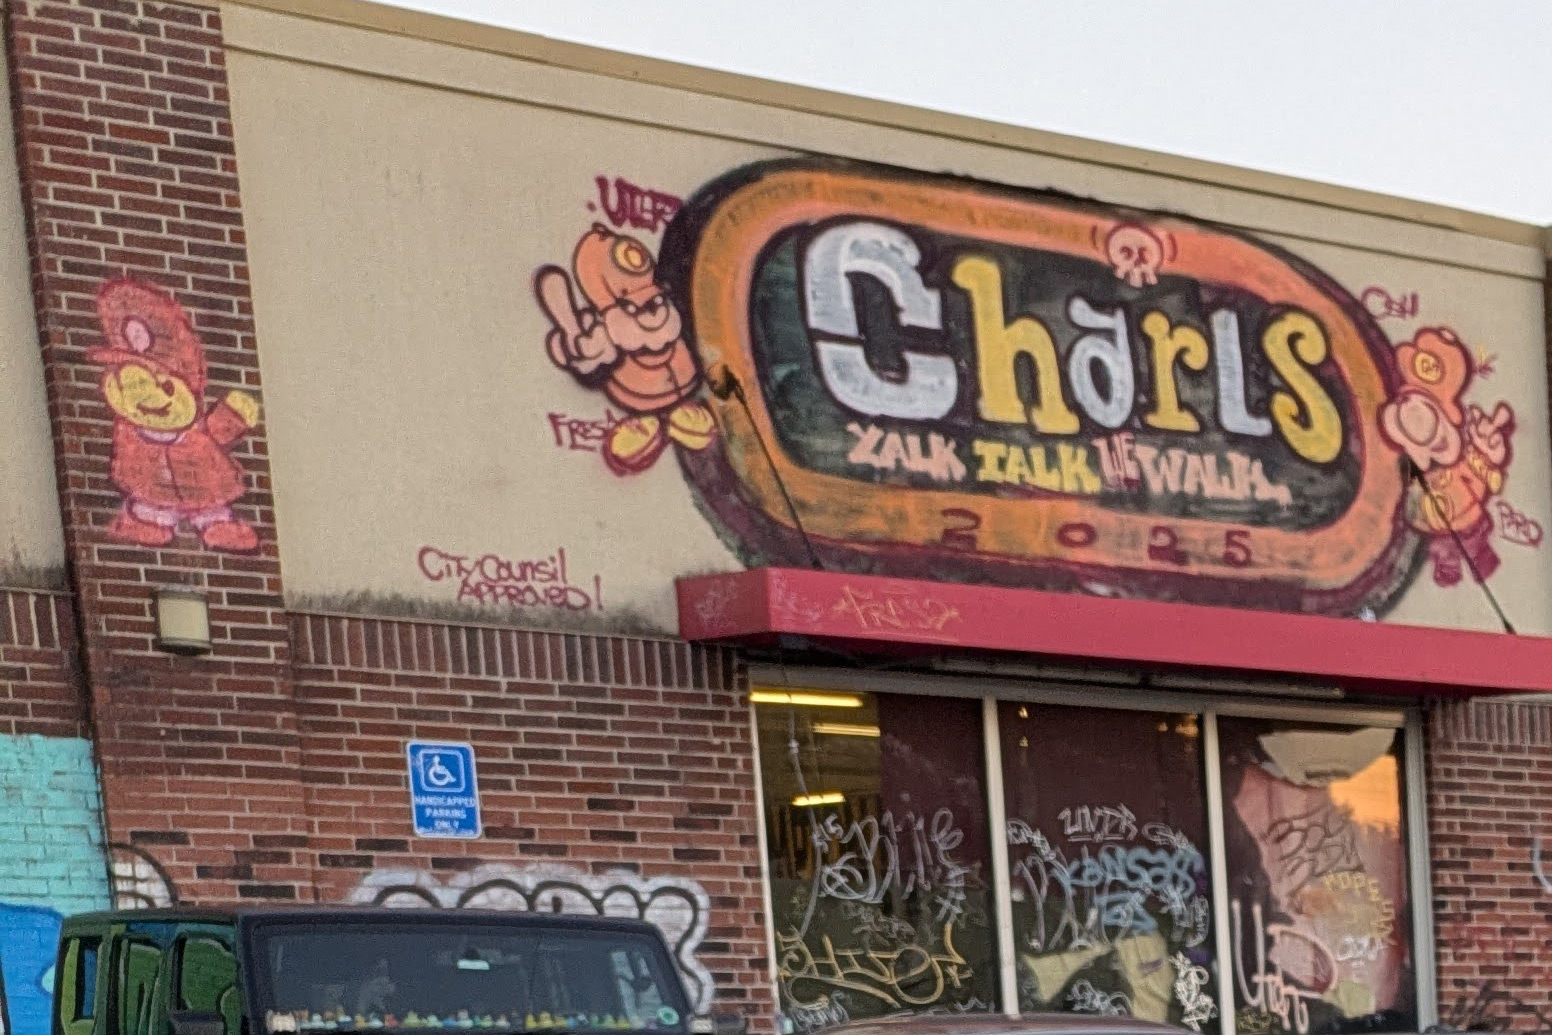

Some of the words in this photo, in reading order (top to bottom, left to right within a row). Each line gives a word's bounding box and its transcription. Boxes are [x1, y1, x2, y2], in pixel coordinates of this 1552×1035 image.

[973, 437, 1102, 495] TALK
[415, 795, 476, 808] HANDICAPPED
[425, 807, 467, 819] PARKING
[434, 820, 460, 829] ONLY
